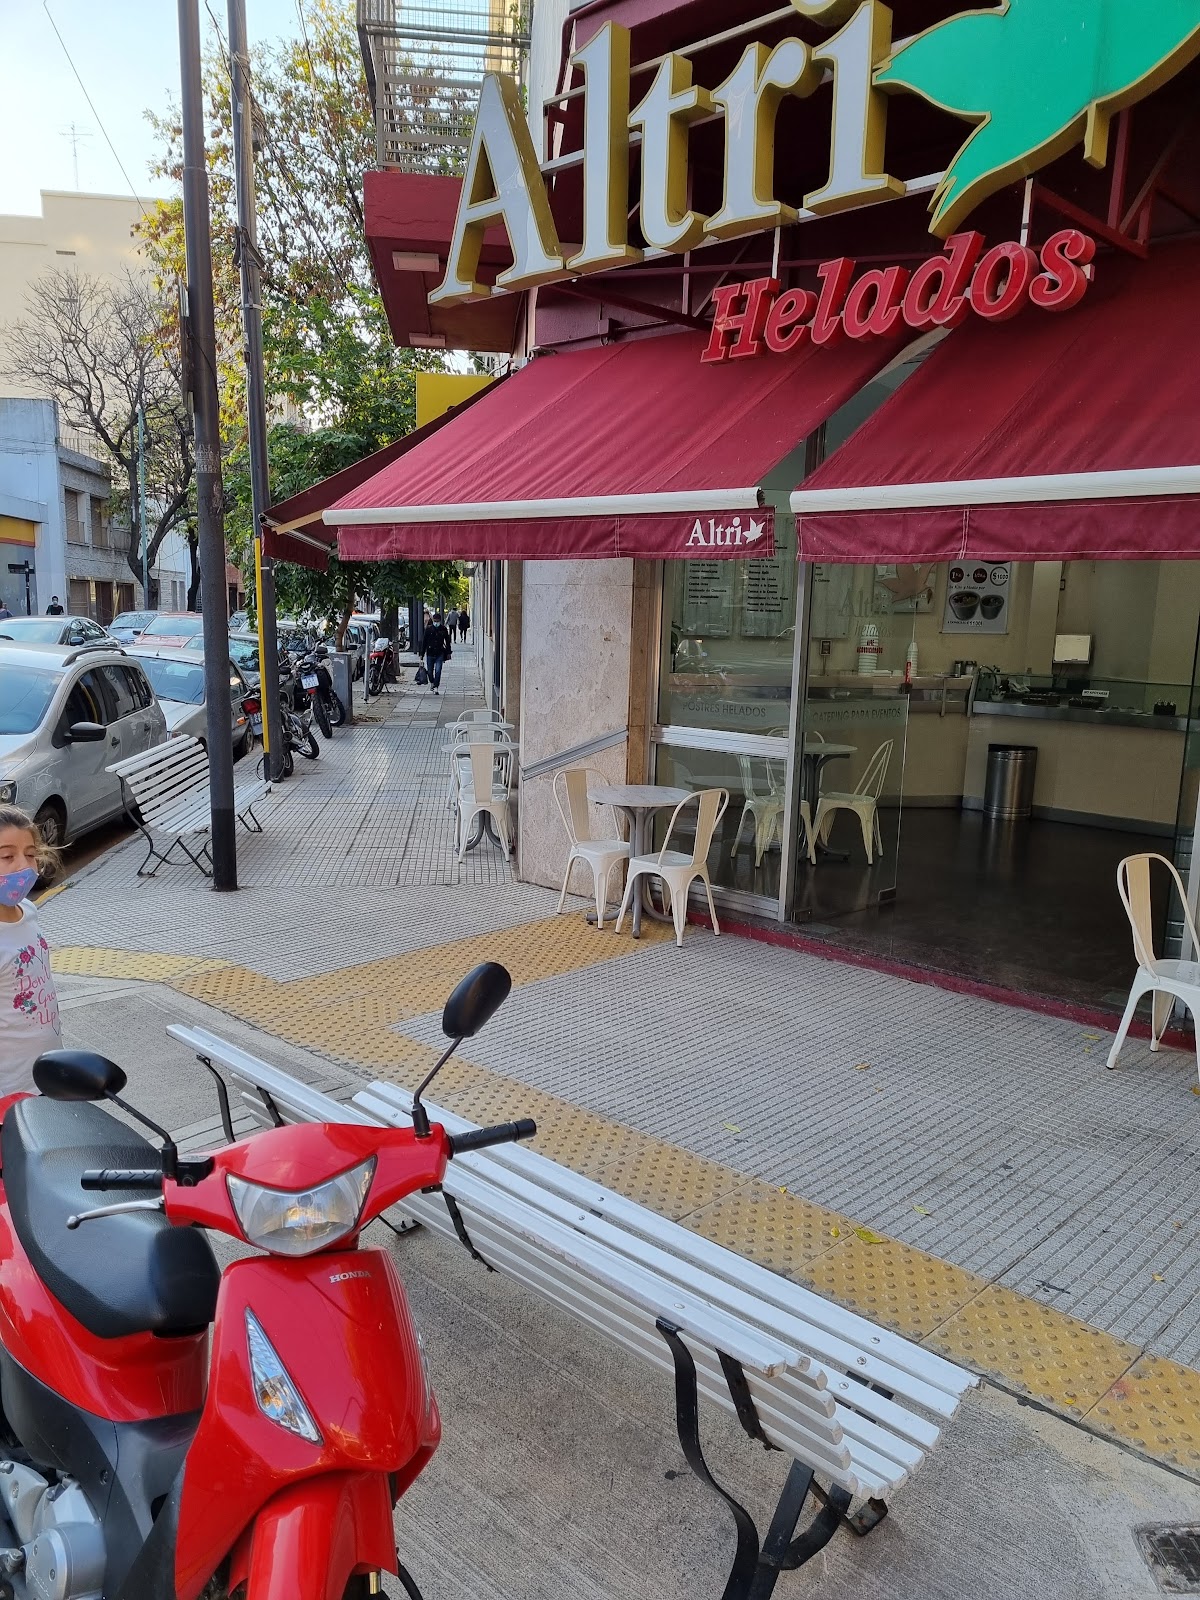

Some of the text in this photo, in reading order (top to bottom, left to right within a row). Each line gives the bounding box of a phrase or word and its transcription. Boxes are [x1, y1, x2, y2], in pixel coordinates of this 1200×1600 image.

[428, 0, 906, 305] Altri
[700, 230, 1096, 364] Helados
[685, 516, 743, 546] Altri
[682, 701, 766, 718] POSTRES HELADOS
[851, 710, 872, 721] PARA
[872, 707, 902, 719] EVENTOS
[328, 1271, 372, 1283] HONDA
